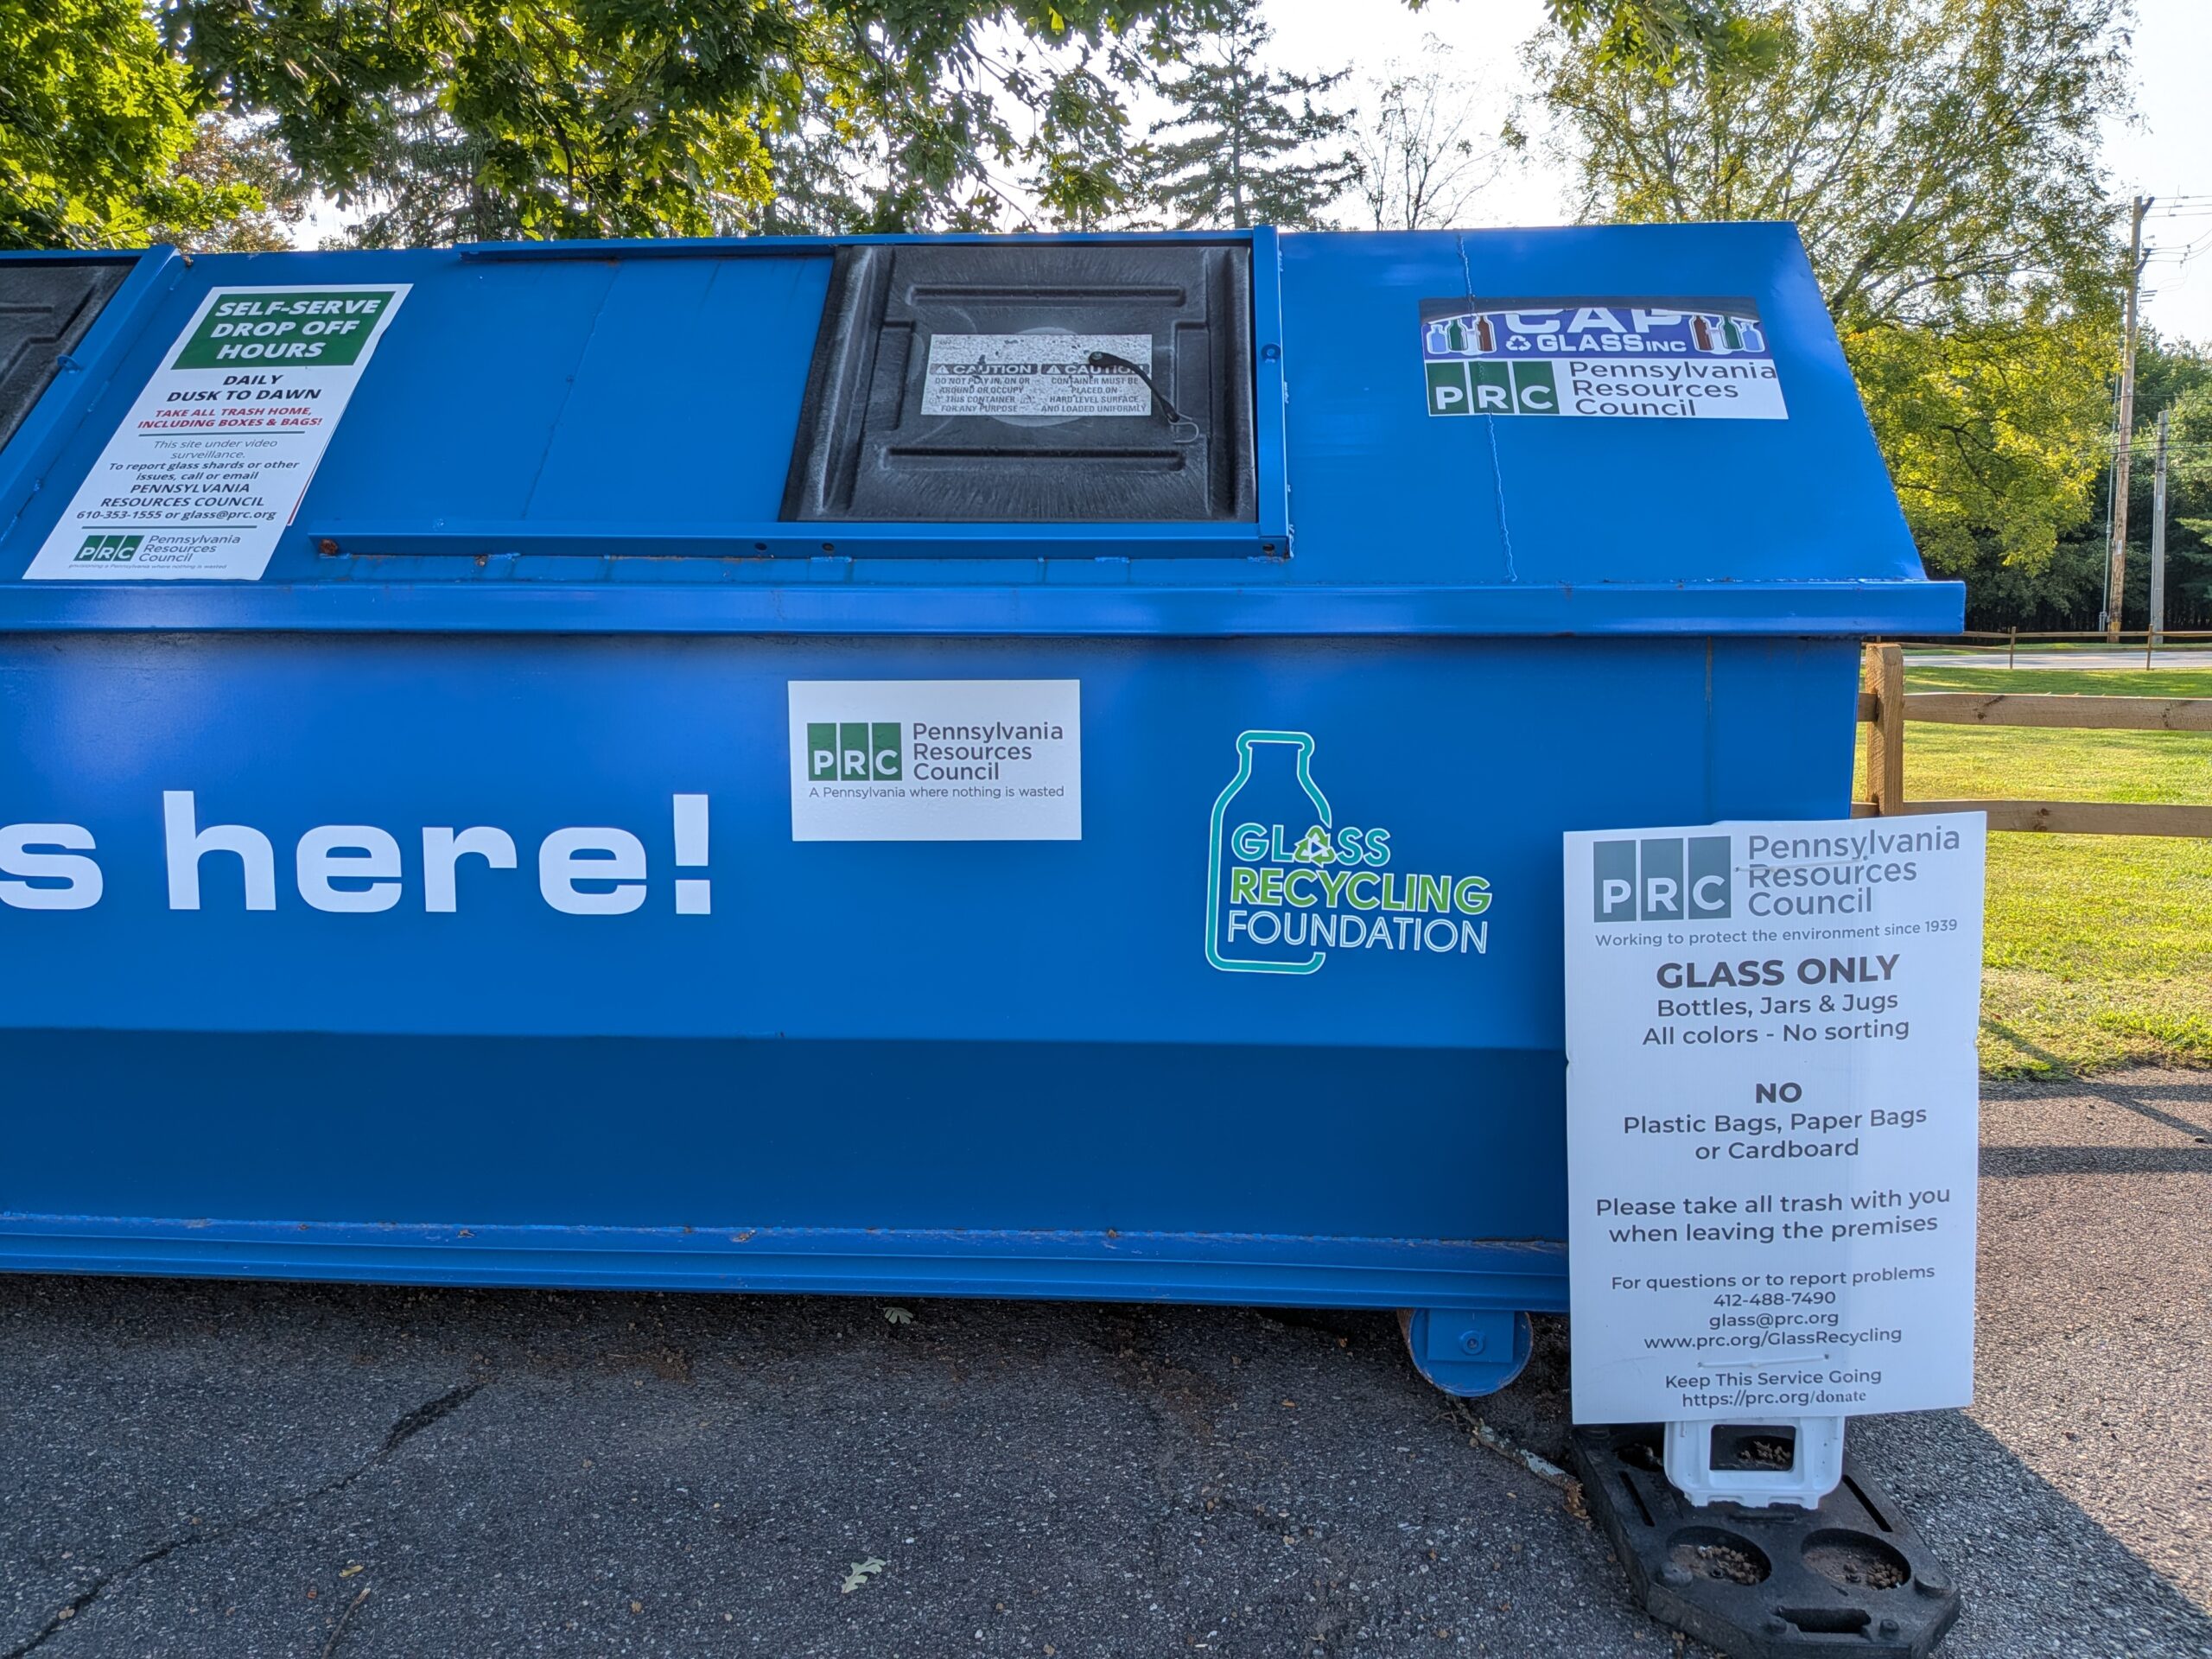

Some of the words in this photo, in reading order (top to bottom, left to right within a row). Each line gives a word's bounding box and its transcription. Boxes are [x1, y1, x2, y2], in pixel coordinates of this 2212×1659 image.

[215, 299, 381, 317] SELF-SERVE
[210, 321, 296, 338] DROP
[302, 320, 360, 335] OFF
[216, 342, 327, 359] HOURS
[1537, 334, 1643, 353] GLASS
[1645, 340, 1686, 353] INC
[953, 365, 1032, 374] CAUTION
[1570, 360, 1777, 382] Pennsylvania
[223, 374, 284, 385] DAILY
[1573, 379, 1738, 398] Resources
[166, 391, 221, 402] DUSK
[226, 390, 251, 400] TO
[256, 389, 322, 400] DAWN
[1436, 385, 1554, 410] PRC
[156, 409, 188, 418] TAKE
[221, 408, 265, 416] TRASH
[268, 407, 312, 416] HOME,
[1575, 398, 1695, 416] Council
[137, 418, 215, 429] INCLUDING
[154, 441, 177, 449] This
[180, 440, 203, 448] site
[207, 439, 242, 448] under
[245, 439, 278, 448] video
[170, 450, 245, 460] surveillance.
[125, 463, 166, 473] report
[167, 461, 200, 473] glass
[136, 473, 175, 482] issues,
[181, 472, 204, 480] call
[223, 472, 259, 480] email
[130, 484, 251, 494] PENNSYLVANIA
[100, 498, 191, 507] RESOURCES
[194, 497, 265, 507] COUNCIL
[76, 510, 162, 519] 610-353-1555
[182, 510, 277, 522] glass@prc.org
[143, 544, 217, 553] Resources
[149, 535, 241, 545] Pennsylvania
[79, 547, 135, 559] PRC
[138, 553, 193, 562] Council
[913, 721, 1063, 743] Pennsylvania
[913, 743, 1032, 760] Resources
[813, 749, 899, 775] PRC
[913, 762, 1000, 780] Council
[809, 788, 819, 798] A
[823, 786, 906, 800] Pennsylvania
[910, 786, 949, 798] where
[952, 786, 1001, 799] nothing
[1005, 786, 1015, 798] is
[1019, 786, 1065, 798] wasted
[162, 789, 712, 915] here!
[1749, 826, 1961, 861] Pennsylvania
[1749, 860, 1917, 888] Resources
[1230, 867, 1492, 915] RECYCLING
[1602, 874, 1726, 913] PRC
[1748, 888, 1872, 917] Council
[1228, 910, 1488, 954] FOUNDATION
[1595, 933, 1662, 948] Working
[1668, 931, 1684, 945] to
[1688, 930, 1747, 946] protect
[1752, 928, 1778, 943] the
[1782, 925, 1880, 942] environment
[1884, 922, 1921, 938] since
[1924, 918, 1958, 933] 1939
[1656, 959, 1785, 989] GLASS
[1796, 954, 1900, 985] ONLY
[1657, 997, 1753, 1019] Bottles,
[1760, 995, 1811, 1016] Jars
[1819, 995, 1836, 1013] &
[1842, 994, 1899, 1016] Jugs
[1642, 1027, 1675, 1046] All
[1682, 1024, 1758, 1045] colors
[1783, 1023, 1817, 1042] No
[1824, 1020, 1910, 1045] sorting
[1755, 1082, 1802, 1105] NO
[1624, 1116, 1707, 1135] Plastic
[1714, 1115, 1782, 1137] Bags,
[1790, 1112, 1862, 1135] Paper
[1870, 1108, 1928, 1128] Bags
[1695, 1146, 1720, 1160] or
[1728, 1138, 1859, 1160] Cardboard
[1596, 1198, 1676, 1217] Please
[1683, 1196, 1738, 1215] take
[1744, 1195, 1772, 1213] all
[1780, 1192, 1843, 1213] trash
[1851, 1189, 1903, 1211] with
[1908, 1188, 1951, 1209] you
[1609, 1224, 1678, 1243] when
[1686, 1222, 1775, 1245] leaving
[1782, 1222, 1823, 1239] the
[1831, 1217, 1939, 1242] premises
[1611, 1275, 1642, 1291] For
[1646, 1274, 1737, 1293] questions
[1741, 1274, 1761, 1287] or
[1764, 1274, 1785, 1287] to
[1789, 1271, 1847, 1289] report
[1852, 1266, 1936, 1287] problems
[1713, 1291, 1836, 1308] 412-488-7490
[1709, 1311, 1839, 1332] glass@prc.org
[1643, 1327, 1902, 1351] www.prc.org/GlassRecycling
[1665, 1374, 1711, 1391] Keep
[1715, 1372, 1752, 1388] This
[1758, 1370, 1824, 1387] Service
[1828, 1367, 1882, 1388] Going
[1681, 1389, 1867, 1409] https://prc.org/donate
